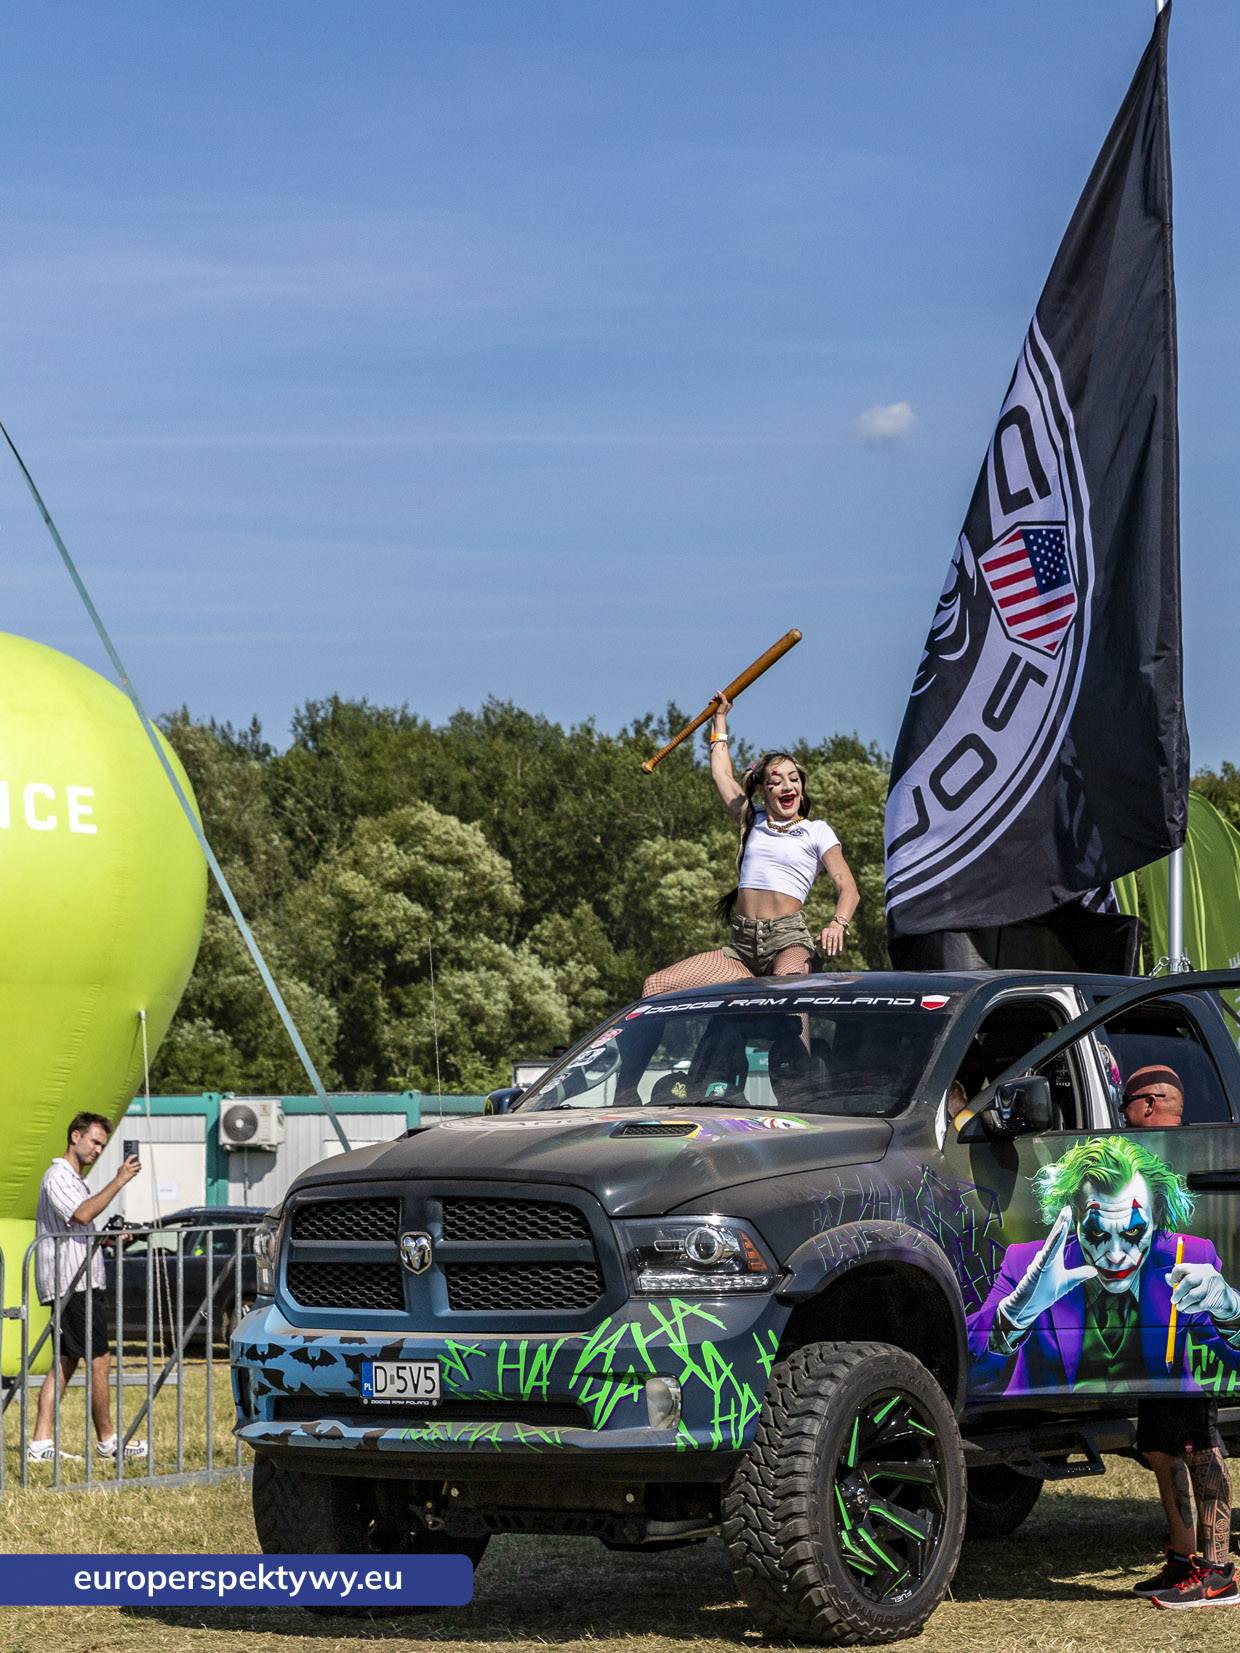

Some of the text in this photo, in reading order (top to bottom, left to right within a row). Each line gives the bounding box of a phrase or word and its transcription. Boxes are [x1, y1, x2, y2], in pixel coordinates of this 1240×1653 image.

[644, 997, 916, 1014] DODGE RAM POLAND
[363, 1382, 373, 1391] PL
[396, 1366, 436, 1394] 5V5
[890, 1589, 913, 1603] FUEL
